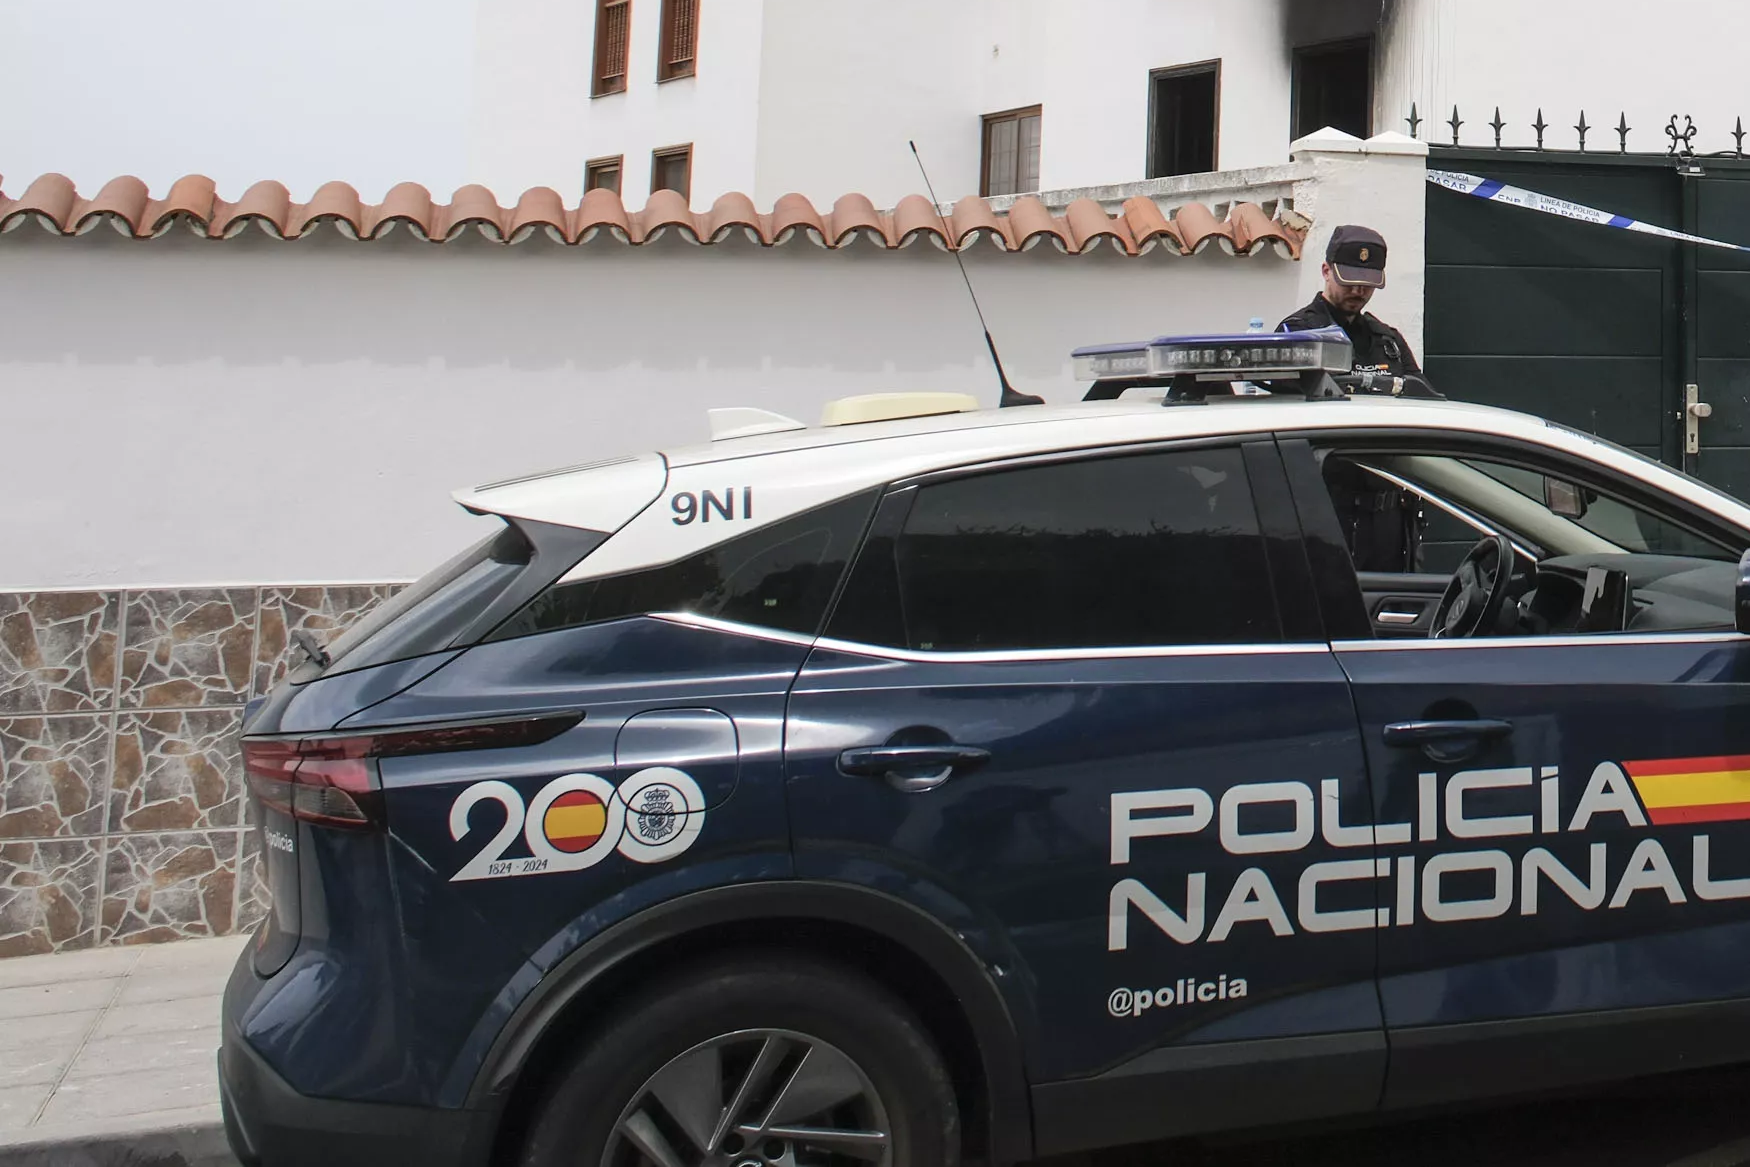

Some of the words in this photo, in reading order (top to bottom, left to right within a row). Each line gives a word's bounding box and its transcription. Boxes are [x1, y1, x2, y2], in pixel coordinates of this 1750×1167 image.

[1441, 171, 1469, 183] OLICIA
[1540, 197, 1561, 208] LINEA
[1562, 202, 1571, 211] DE
[1573, 205, 1601, 218] POLICIA
[671, 485, 752, 526] 9NI
[449, 766, 706, 882] 200
[488, 863, 512, 875] 1824
[523, 859, 548, 872] 2024
[1107, 974, 1248, 1017] @policia
